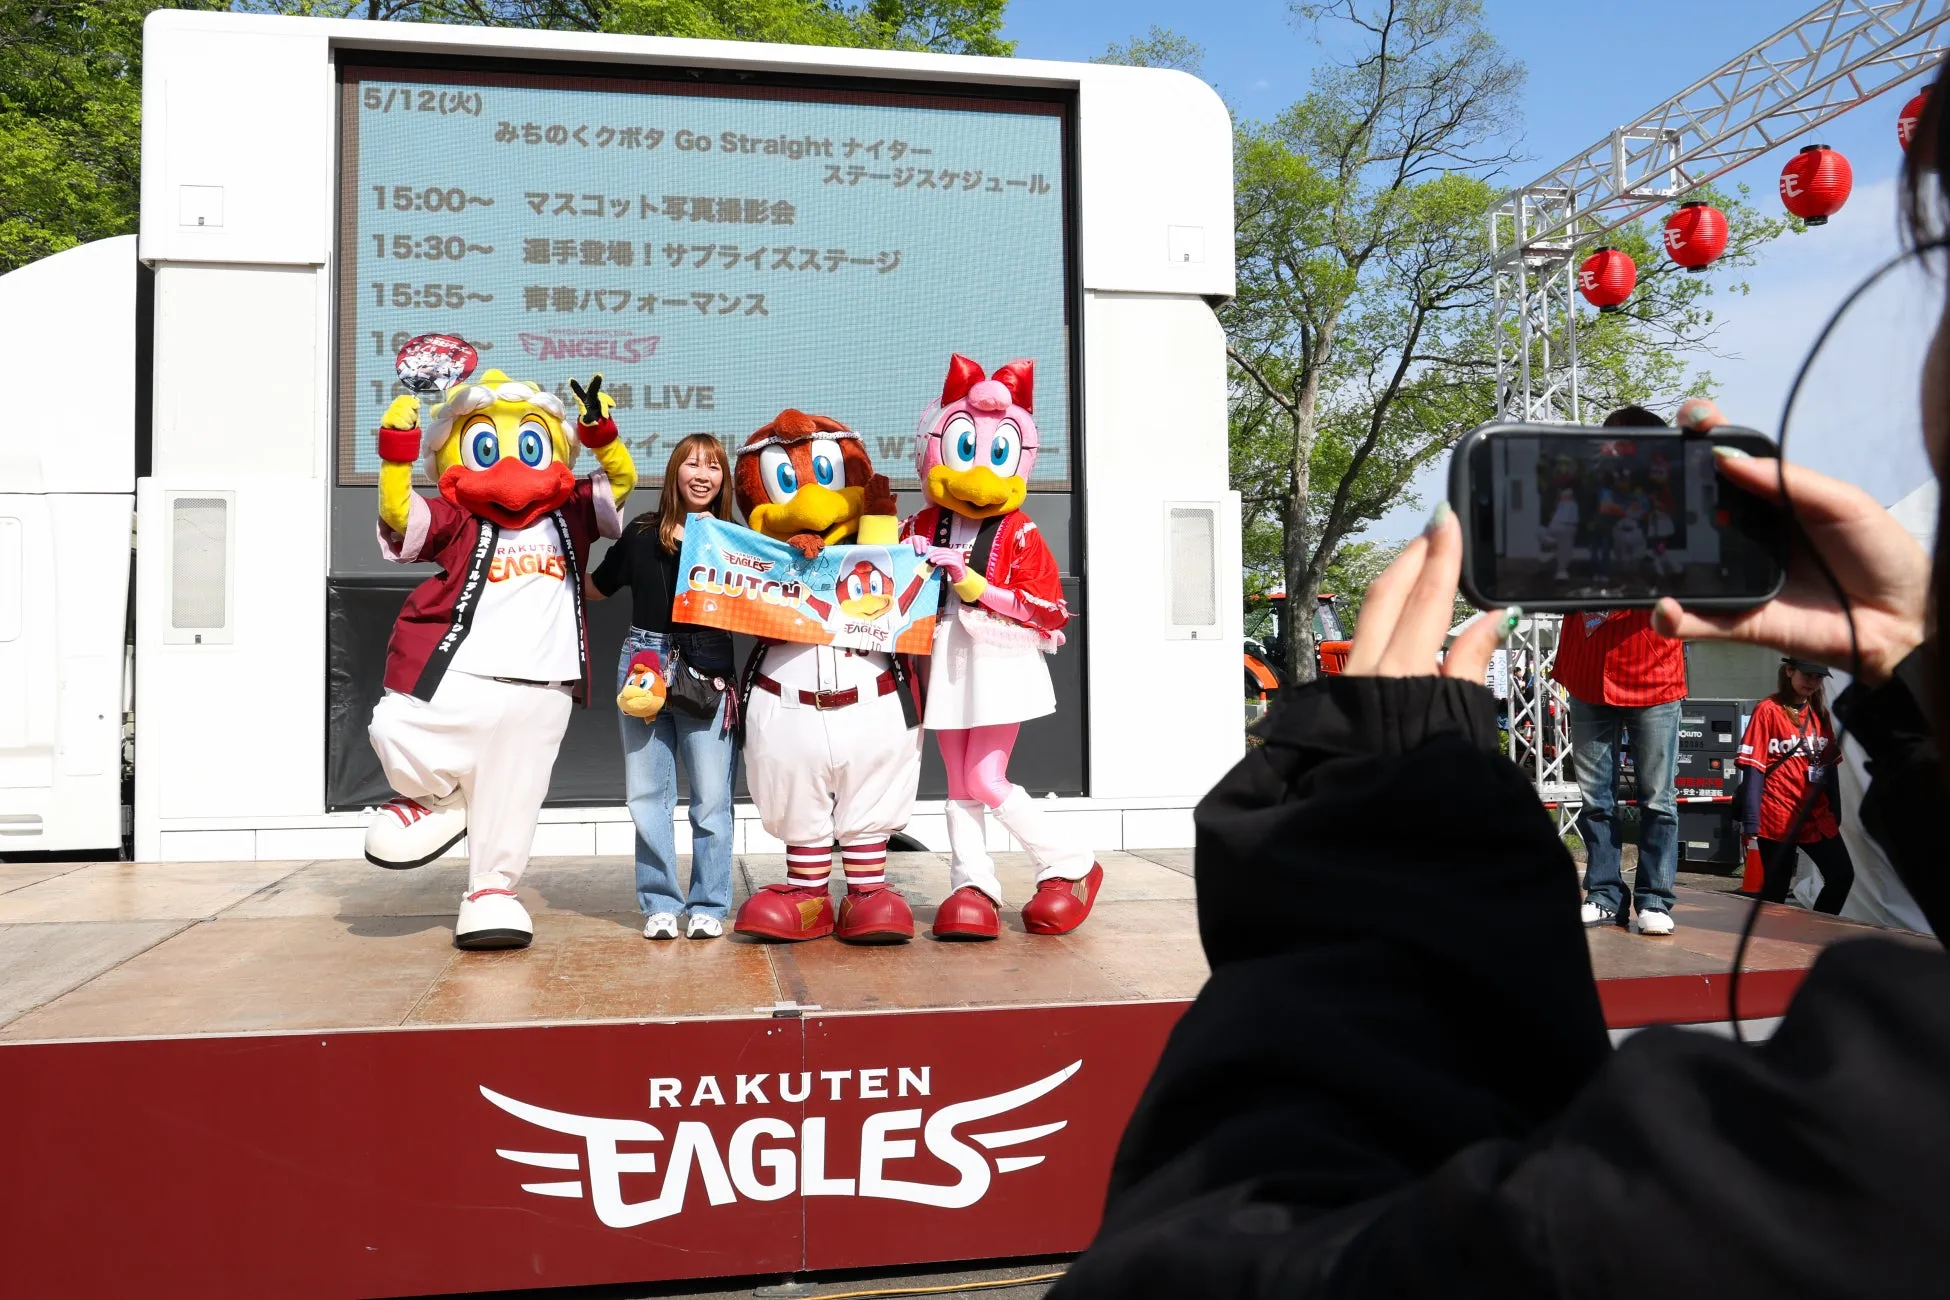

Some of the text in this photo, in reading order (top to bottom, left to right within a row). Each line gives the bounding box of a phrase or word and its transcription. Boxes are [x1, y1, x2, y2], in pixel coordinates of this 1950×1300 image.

[363, 87, 483, 116] 5/12(火)
[494, 121, 932, 160] みちのくクボタ Go Straight ナイター
[823, 164, 1051, 195] ステージスケジュール
[523, 192, 796, 225] マスコット写真撮影会
[523, 285, 769, 316] 青春パフォーマンス
[530, 335, 650, 362] ANGELS
[644, 384, 715, 410] LIVE
[497, 544, 558, 555] RAKUTEN
[725, 552, 769, 572] EAGLES
[487, 553, 567, 582] EAGLES
[689, 564, 801, 608] CLUTCH
[846, 624, 888, 641] EAGLES
[649, 1066, 931, 1108] RAKUTEN
[530, 1085, 1040, 1228] EAGLES
